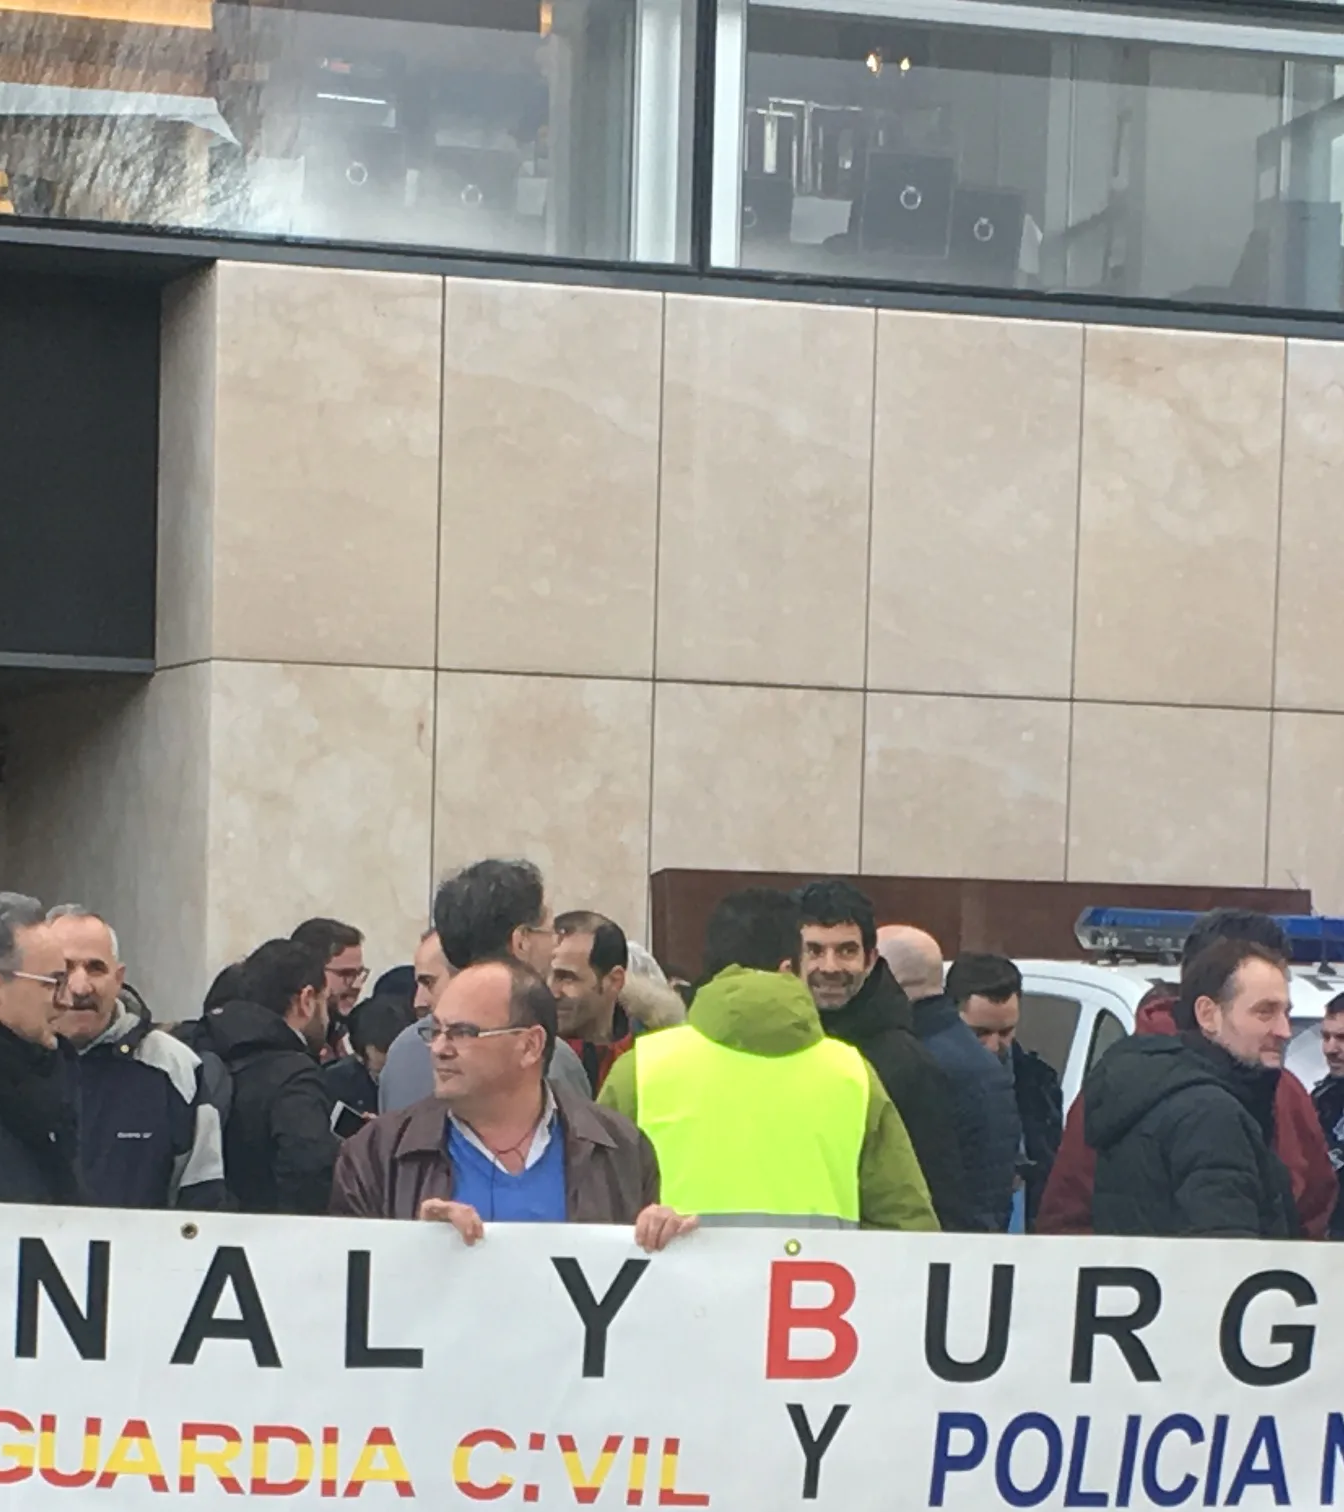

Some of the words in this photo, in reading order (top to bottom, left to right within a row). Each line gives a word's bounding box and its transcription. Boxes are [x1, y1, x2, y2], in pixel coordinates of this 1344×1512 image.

[551, 1257, 650, 1378] Y
[453, 1429, 710, 1506] CIVIL
[787, 1404, 850, 1499] Y
[929, 1412, 1291, 1507] POLICIA
